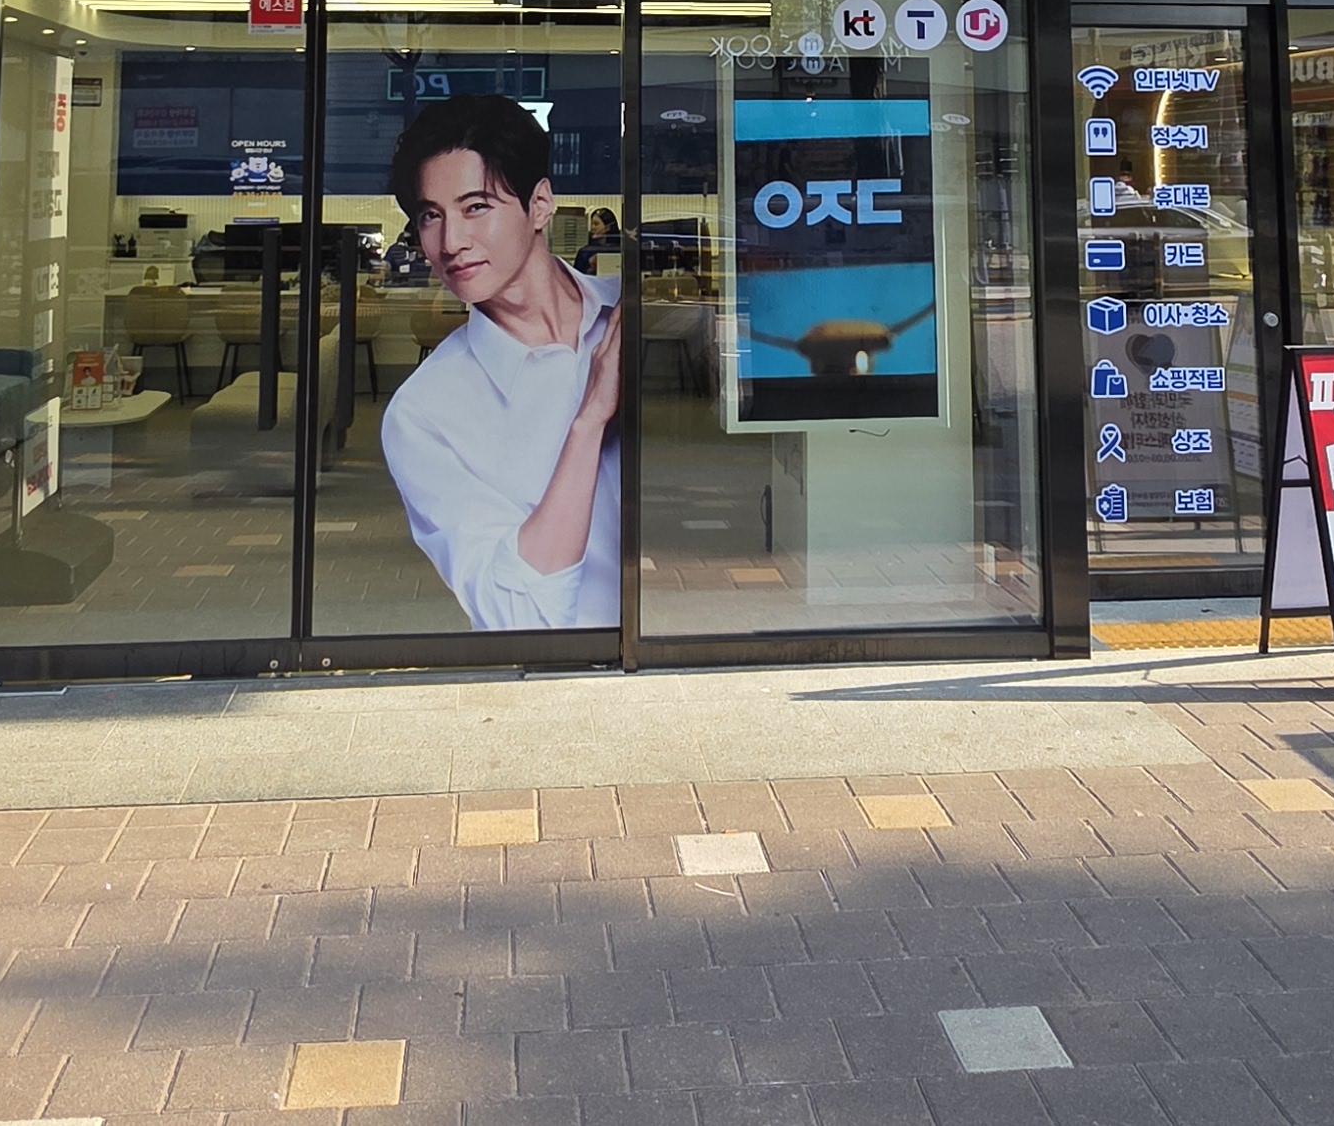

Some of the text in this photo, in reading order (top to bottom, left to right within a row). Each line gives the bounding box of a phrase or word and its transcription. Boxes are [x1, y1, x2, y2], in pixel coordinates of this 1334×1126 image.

[842, 9, 876, 38] kt
[906, 9, 935, 40] T
[1133, 67, 1220, 92] 인터넷TV
[1151, 124, 1209, 148] 정수기
[1153, 183, 1210, 209] 휴대폰
[1164, 243, 1204, 266] 카드
[1143, 303, 1229, 327] 이사·청소
[1149, 367, 1226, 391] 쇼핑적립
[1171, 428, 1213, 455] 상조
[1174, 488, 1215, 514] 보험
